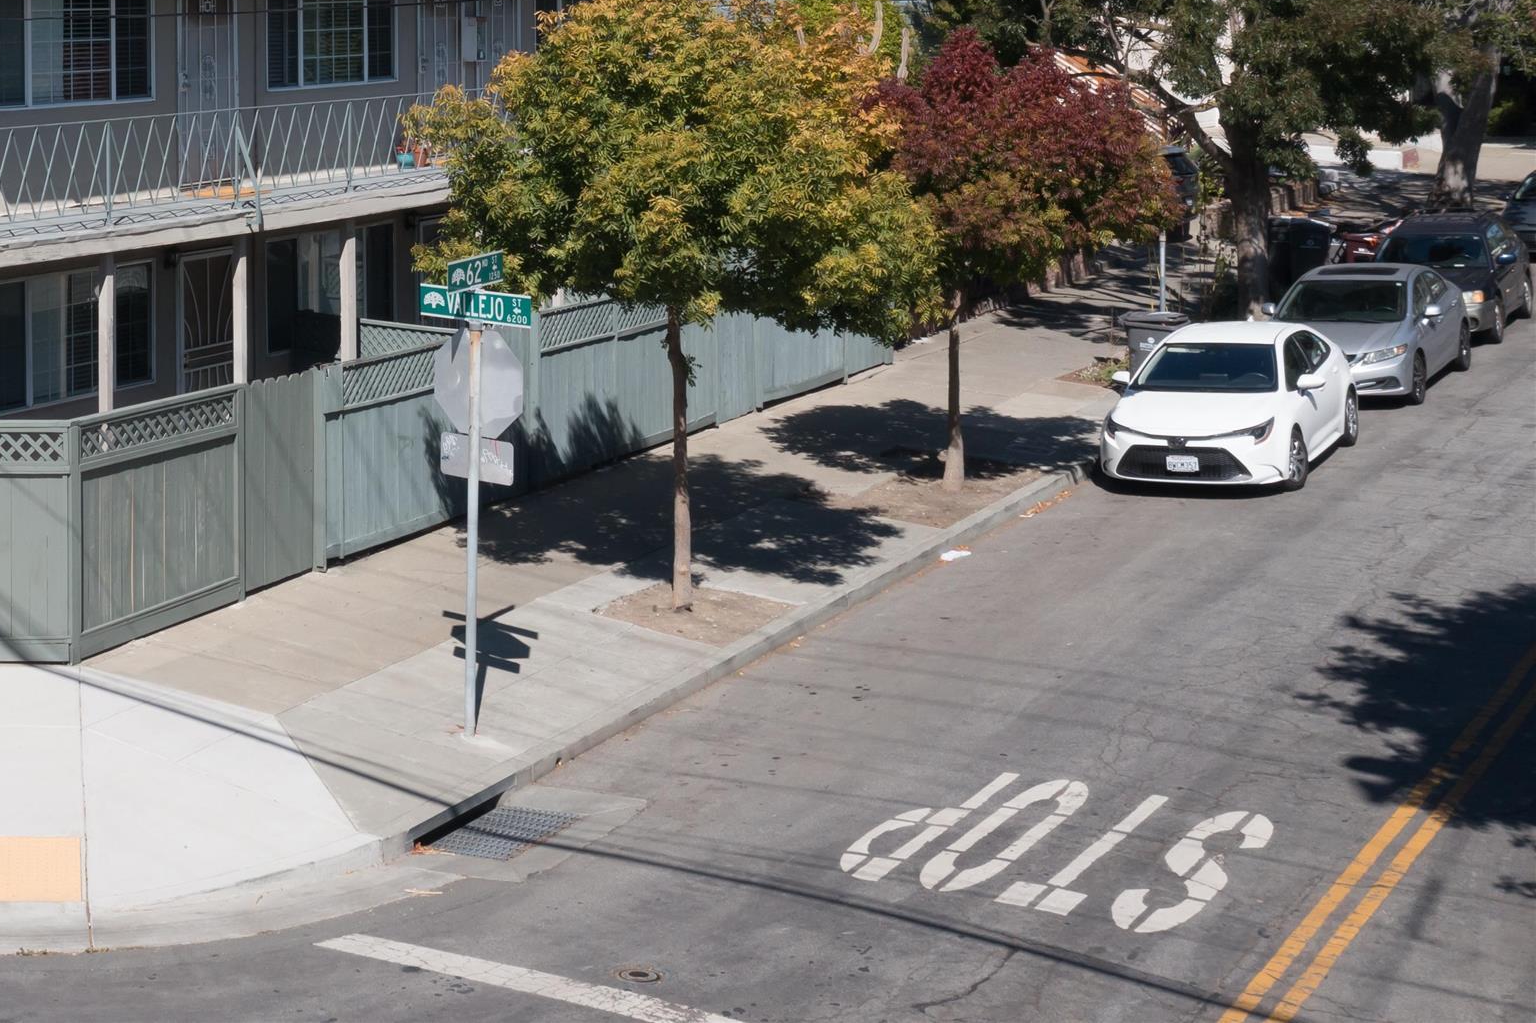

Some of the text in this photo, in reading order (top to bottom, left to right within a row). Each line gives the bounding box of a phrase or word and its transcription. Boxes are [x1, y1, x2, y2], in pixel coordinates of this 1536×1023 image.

[491, 255, 498, 265] ST
[446, 291, 522, 321] VALLEJO ST
[506, 314, 528, 325] 6200
[839, 772, 1275, 933] STOP
